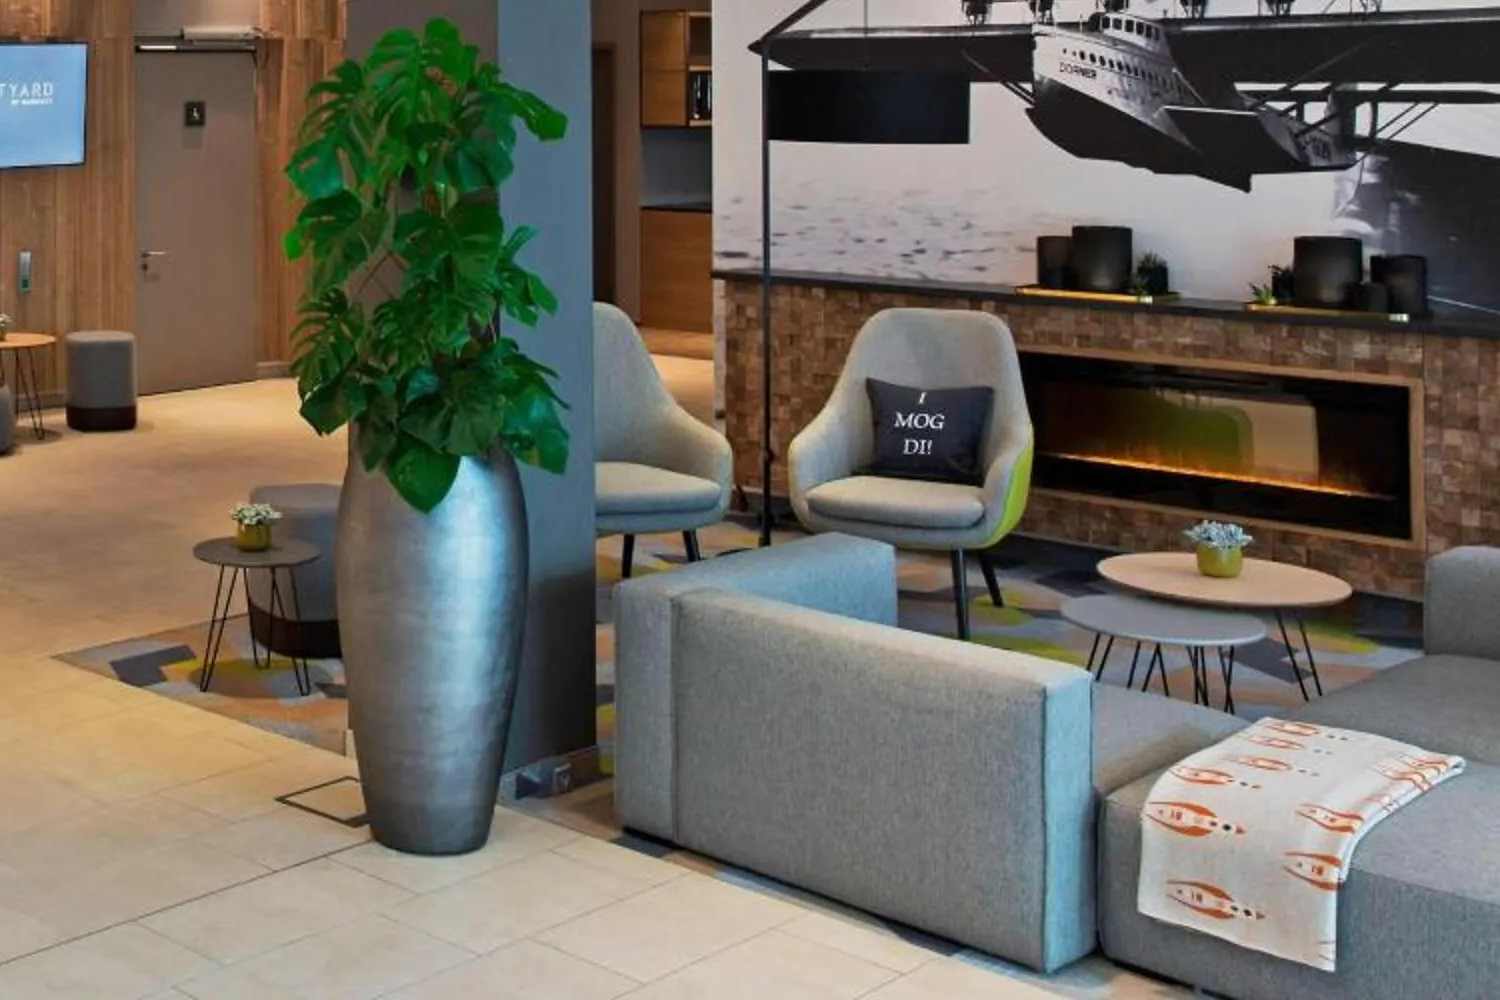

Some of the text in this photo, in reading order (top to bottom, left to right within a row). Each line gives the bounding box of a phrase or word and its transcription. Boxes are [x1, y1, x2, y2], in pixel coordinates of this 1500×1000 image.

[918, 391, 927, 404] I
[893, 411, 946, 430] MOG
[903, 438, 933, 455] DI!
